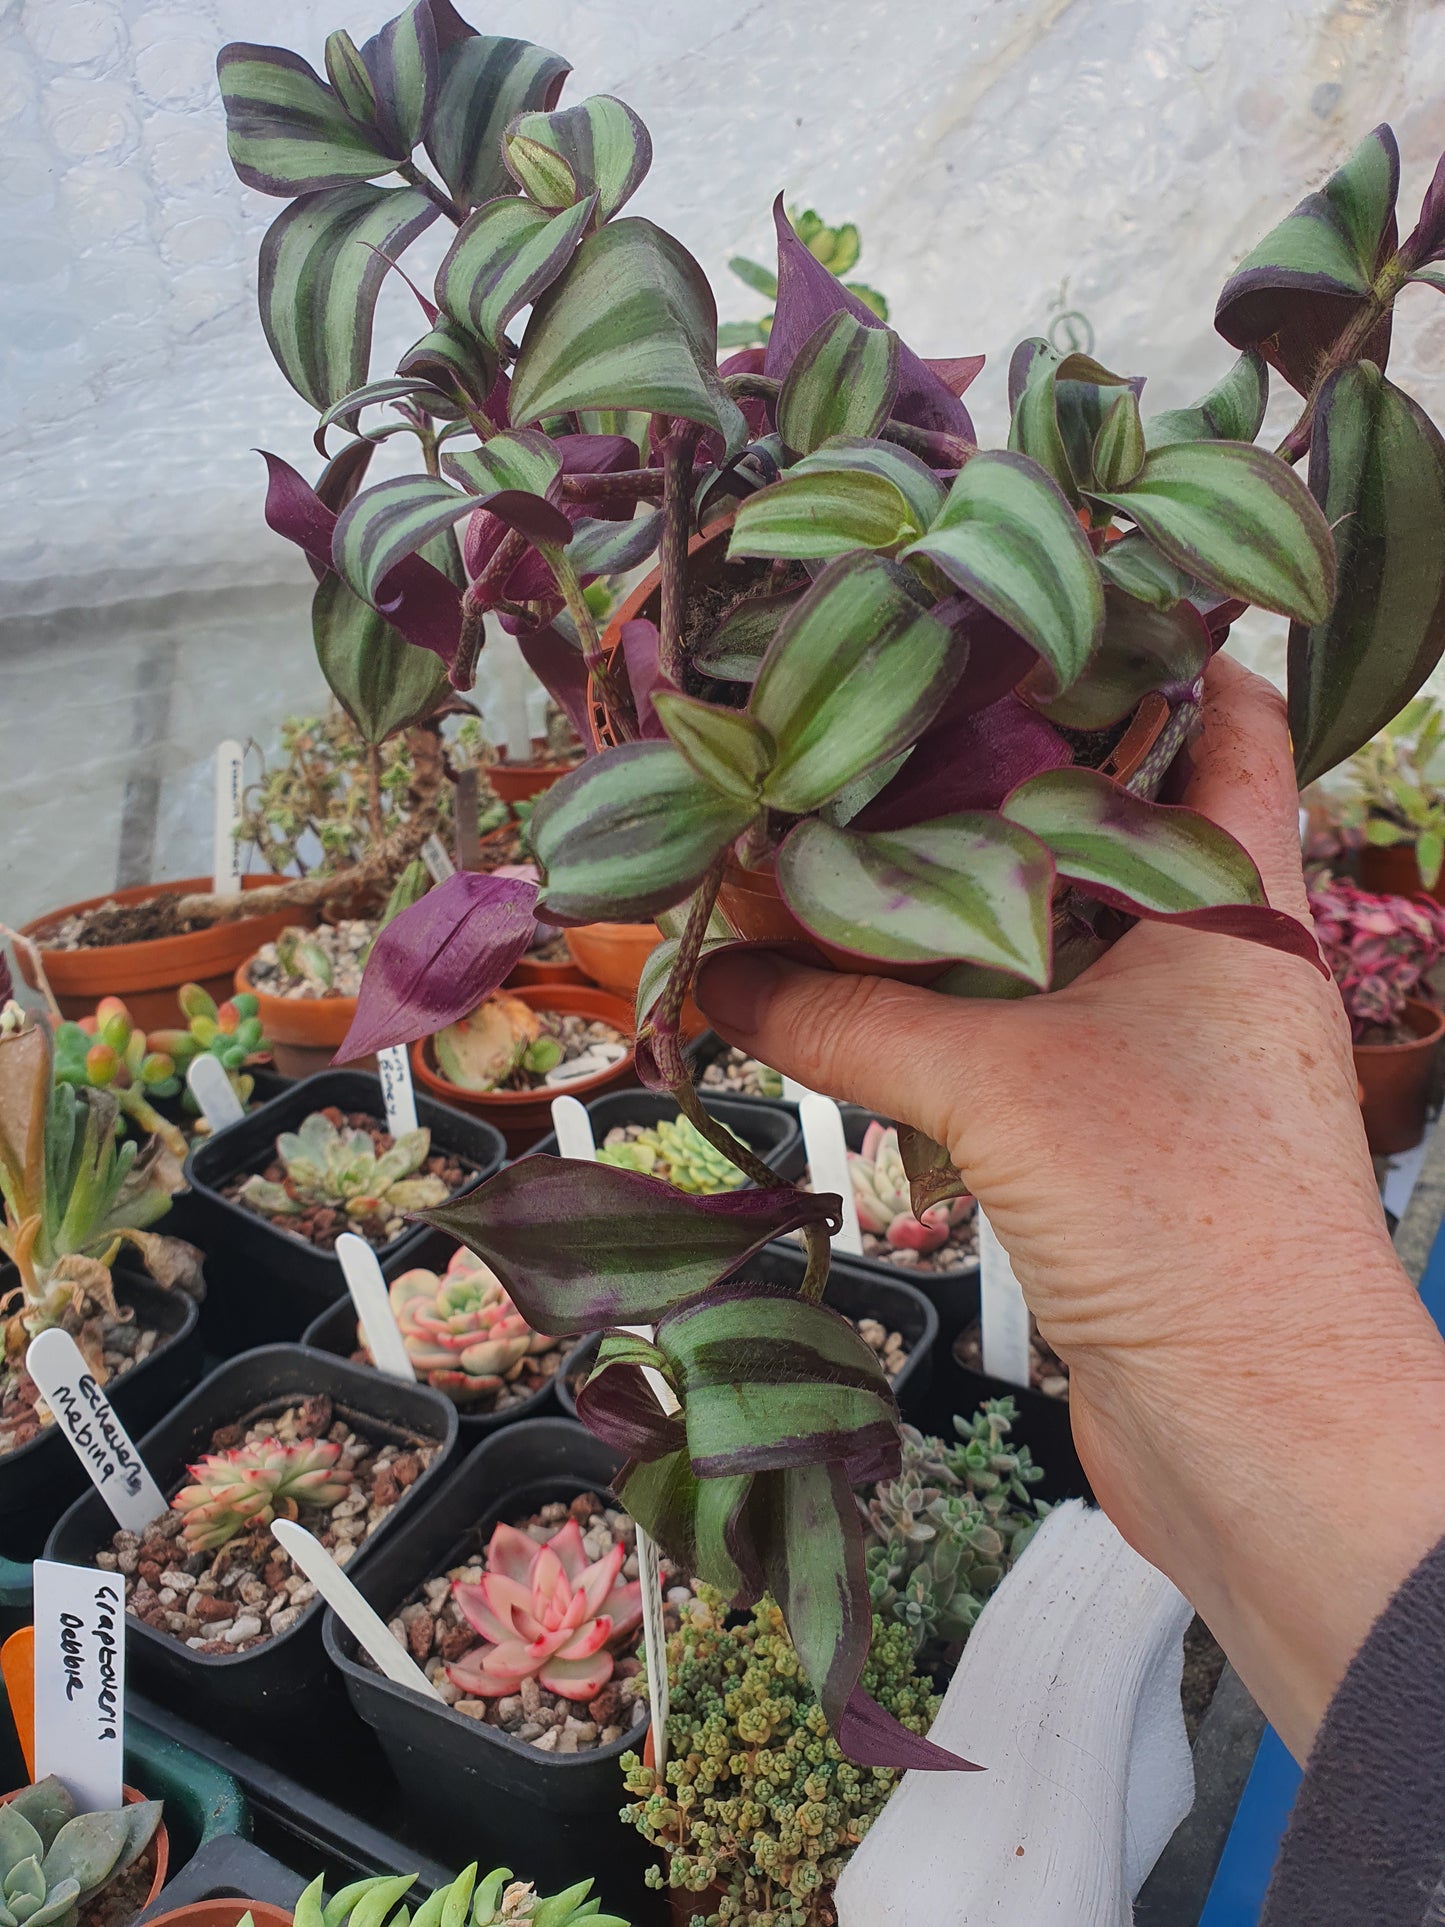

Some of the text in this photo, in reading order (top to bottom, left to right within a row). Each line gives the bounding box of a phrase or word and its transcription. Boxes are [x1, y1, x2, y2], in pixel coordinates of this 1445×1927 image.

[52, 1386, 114, 1484] Mebina
[60, 1612, 86, 1702] Debbie
[92, 1586, 119, 1740] Graptoveria
